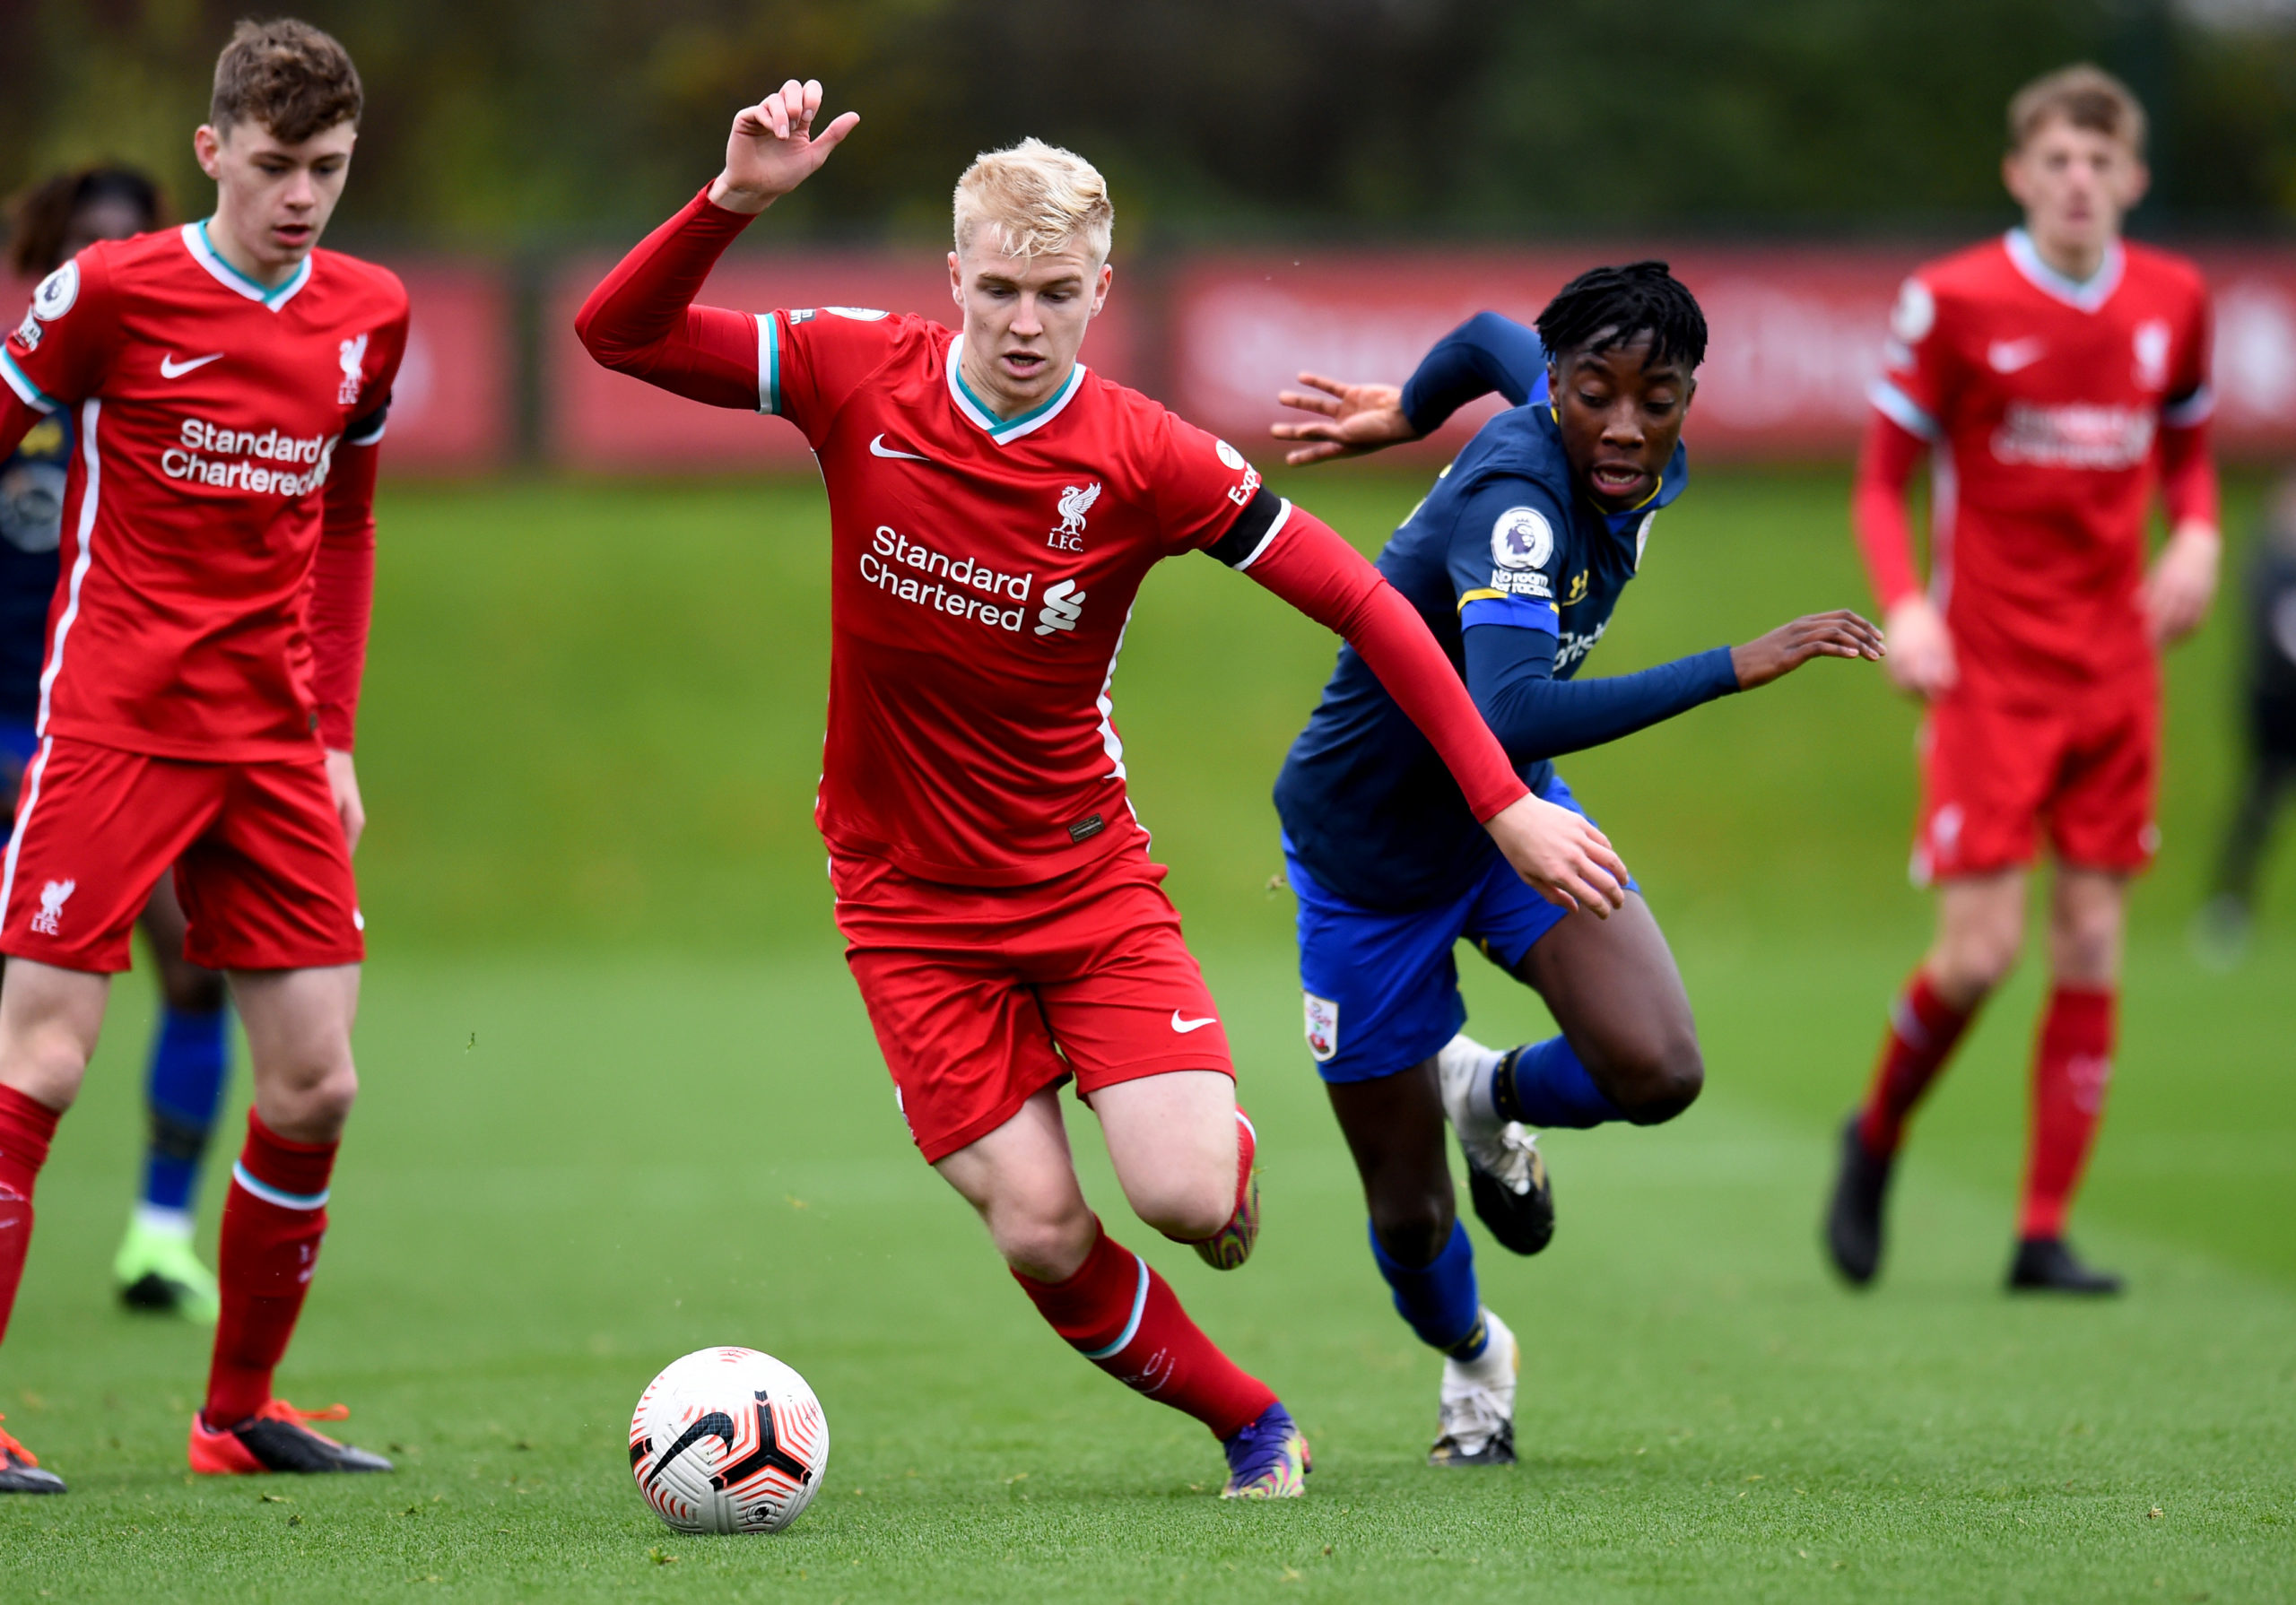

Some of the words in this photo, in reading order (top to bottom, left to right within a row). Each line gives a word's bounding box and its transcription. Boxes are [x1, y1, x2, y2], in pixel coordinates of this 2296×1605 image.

[180, 418, 323, 464] Standard
[860, 553, 1025, 632] Chartered
[873, 525, 1032, 601] Standard
[1492, 568, 1512, 583] No
[1512, 572, 1548, 587] room
